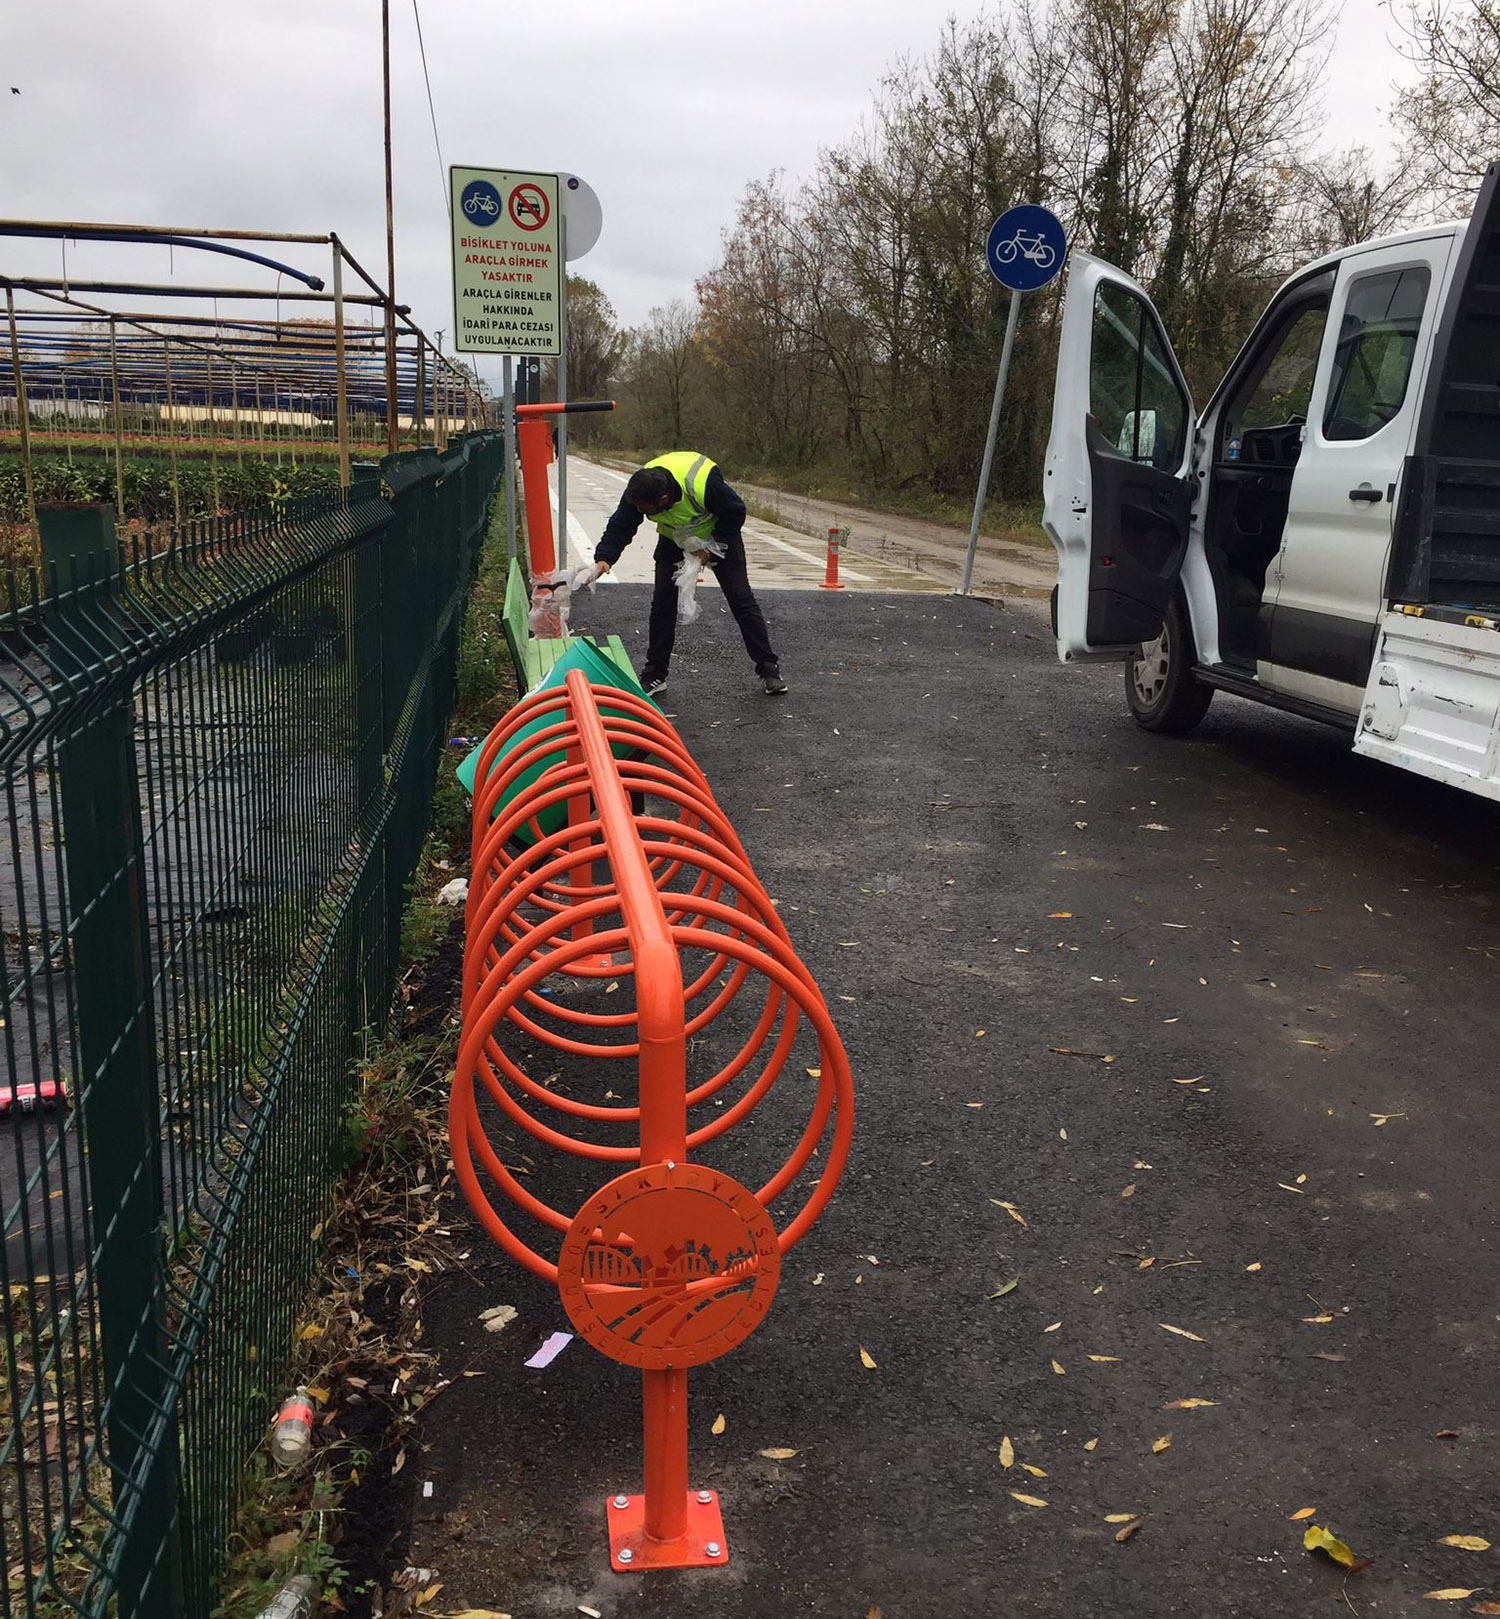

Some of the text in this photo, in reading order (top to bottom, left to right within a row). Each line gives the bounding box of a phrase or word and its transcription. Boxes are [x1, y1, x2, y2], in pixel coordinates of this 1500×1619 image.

[461, 236, 552, 253] BİSİKLET YOLUNA
[465, 255, 548, 268] ARAÇLA GİRMEK
[482, 271, 533, 283] YASAKTIR
[463, 288, 552, 301] ARAÇLA GİRENLER
[483, 305, 534, 316] HAKKINDA
[463, 317, 553, 331] İDARİ PARA CEZASI
[465, 336, 552, 347] UYGULANACAKTIR
